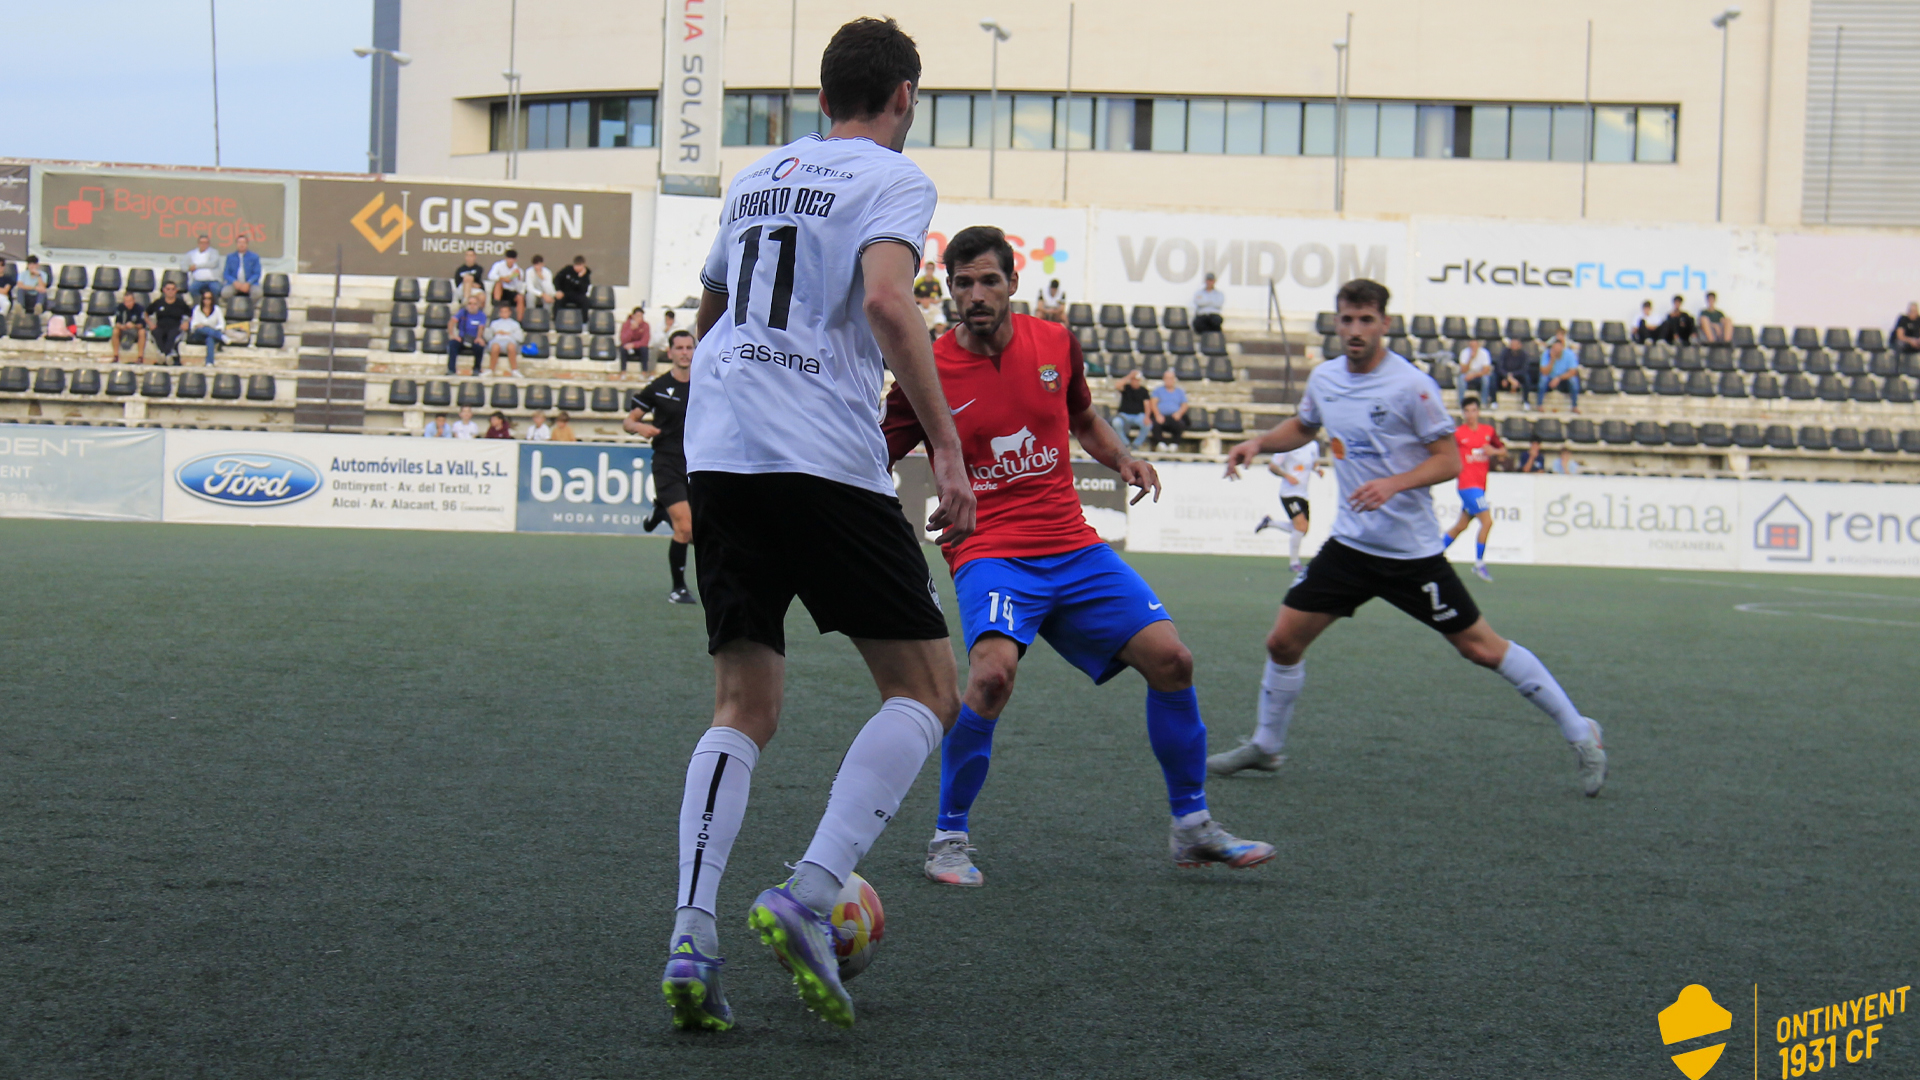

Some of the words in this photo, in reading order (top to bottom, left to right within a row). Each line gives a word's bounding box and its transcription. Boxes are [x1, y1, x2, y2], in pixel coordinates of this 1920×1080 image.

[679, 55, 704, 164] SOLAR
[800, 163, 854, 180] TEXTILES
[113, 188, 237, 220] Bajocoste
[419, 196, 583, 240] GISSAN
[422, 237, 514, 256] INGENIEROS
[735, 224, 798, 332] 11
[204, 457, 293, 498] Ford
[330, 456, 424, 475] Automóviles
[427, 459, 443, 475] La
[446, 460, 478, 479] Vall,
[481, 461, 508, 477] S.L.
[969, 445, 1060, 481] lacturale
[332, 479, 388, 493] Ontinyent
[397, 482, 415, 493] Av.
[418, 482, 435, 493] del
[439, 483, 473, 496] Textil,
[478, 484, 491, 495] 12
[972, 481, 999, 491] leche
[332, 497, 361, 509] Alcoi
[370, 498, 388, 509] Av.
[391, 499, 438, 512] Alacant,
[442, 500, 457, 511] 96
[552, 512, 595, 524] MODA
[1542, 493, 1732, 538] galiana
[988, 591, 1015, 632] 14
